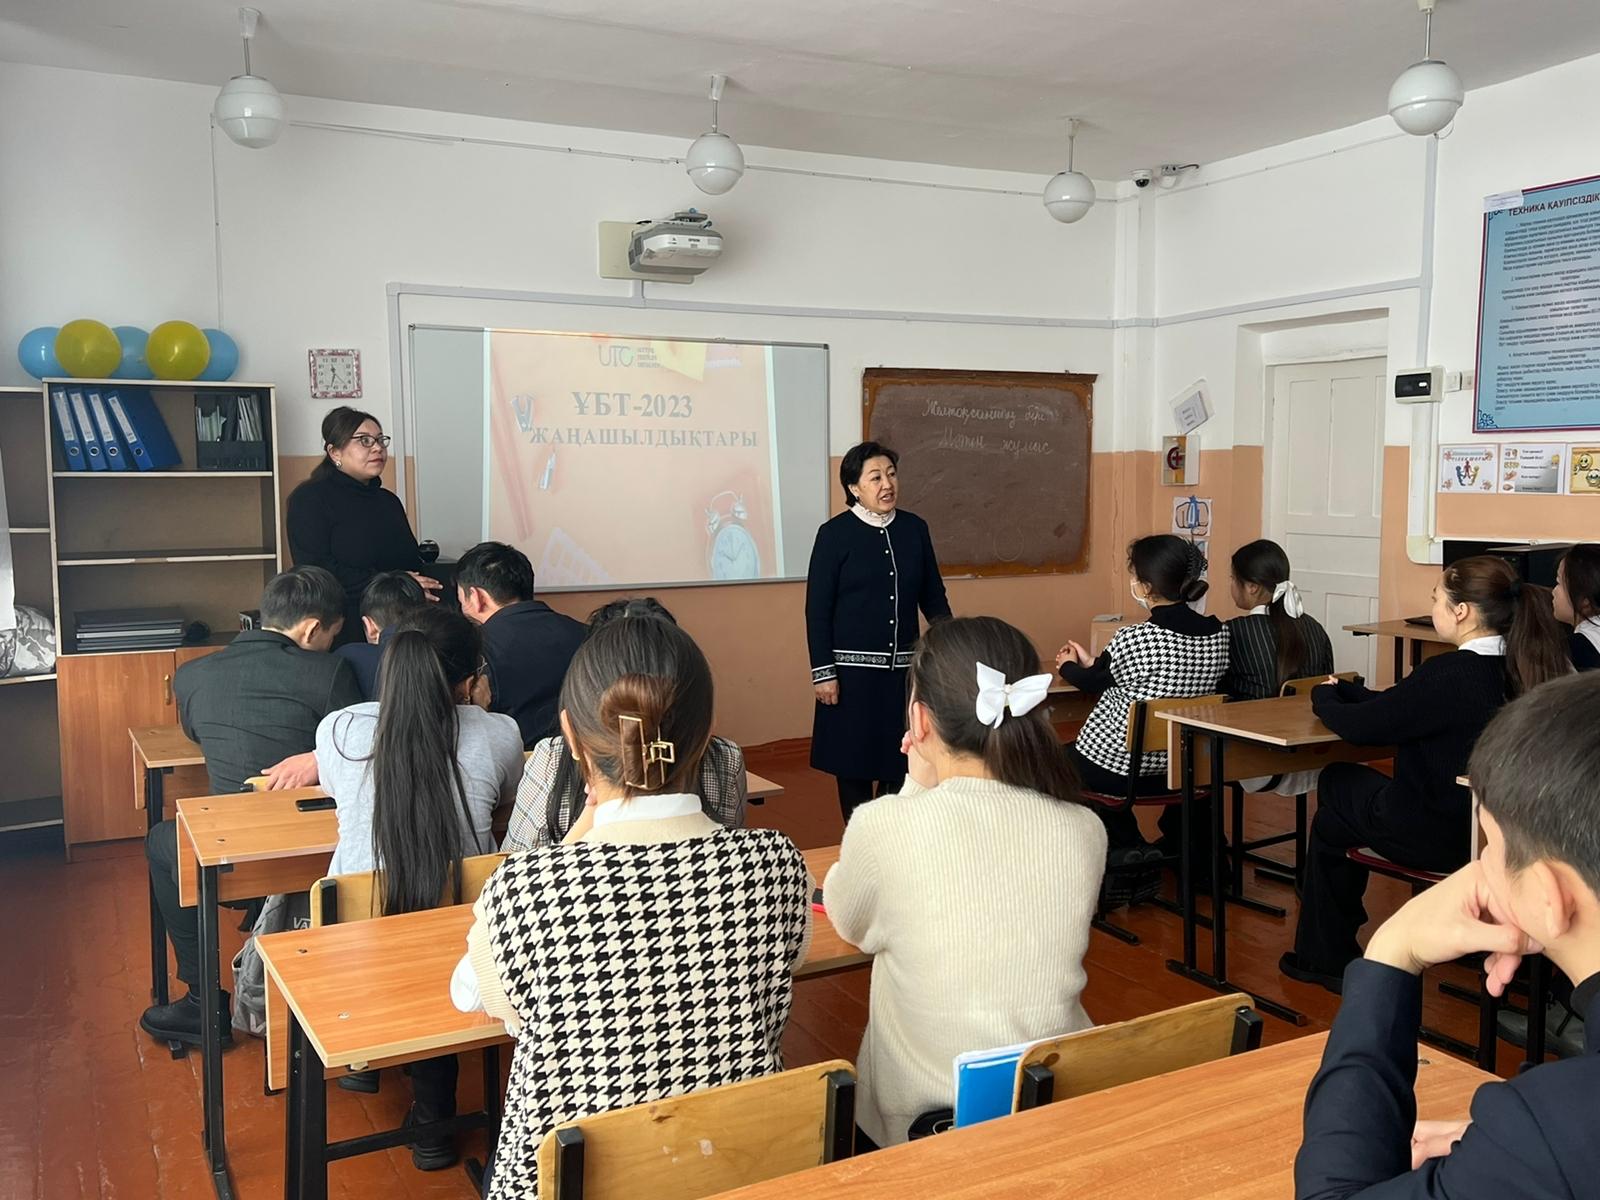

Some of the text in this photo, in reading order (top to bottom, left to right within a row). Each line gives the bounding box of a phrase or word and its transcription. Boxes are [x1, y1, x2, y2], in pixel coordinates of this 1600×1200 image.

[1509, 202, 1546, 217] ТЕХНИКА
[571, 391, 693, 418] ҰБТ-2023
[529, 427, 757, 449] ЖАҢАШЫЛДЫҚТАРЫ
[293, 916, 311, 929] VA
